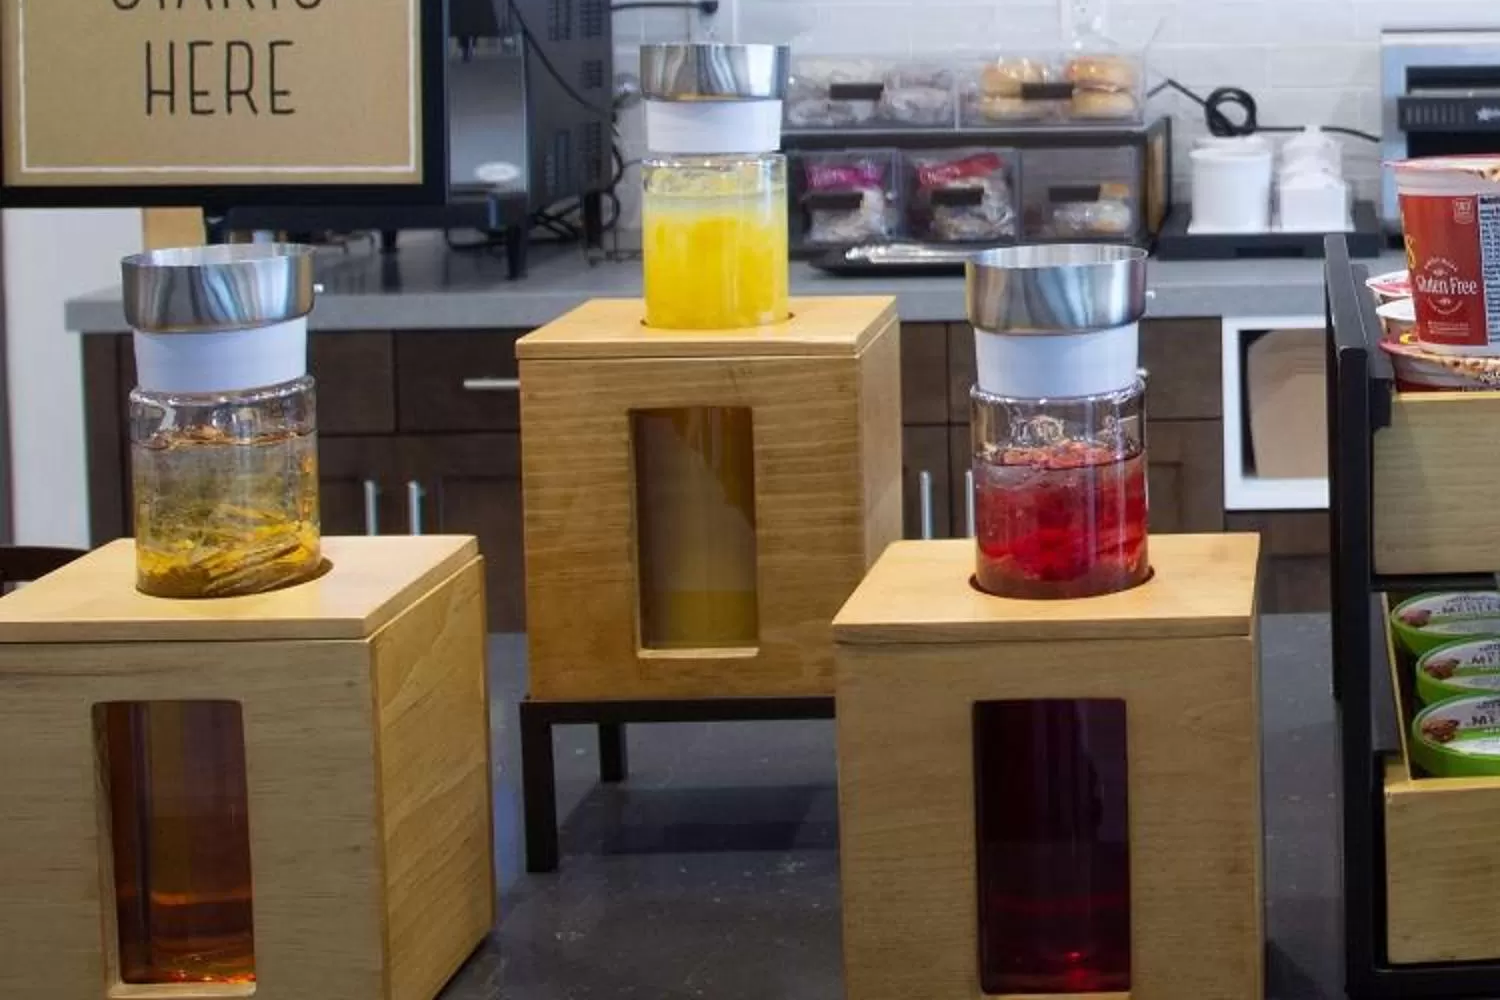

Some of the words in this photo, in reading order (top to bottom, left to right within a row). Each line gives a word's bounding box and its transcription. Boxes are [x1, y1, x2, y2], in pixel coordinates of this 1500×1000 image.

[144, 40, 297, 116] HERE
[1415, 274, 1449, 295] Gluten
[1450, 276, 1477, 296] Free
